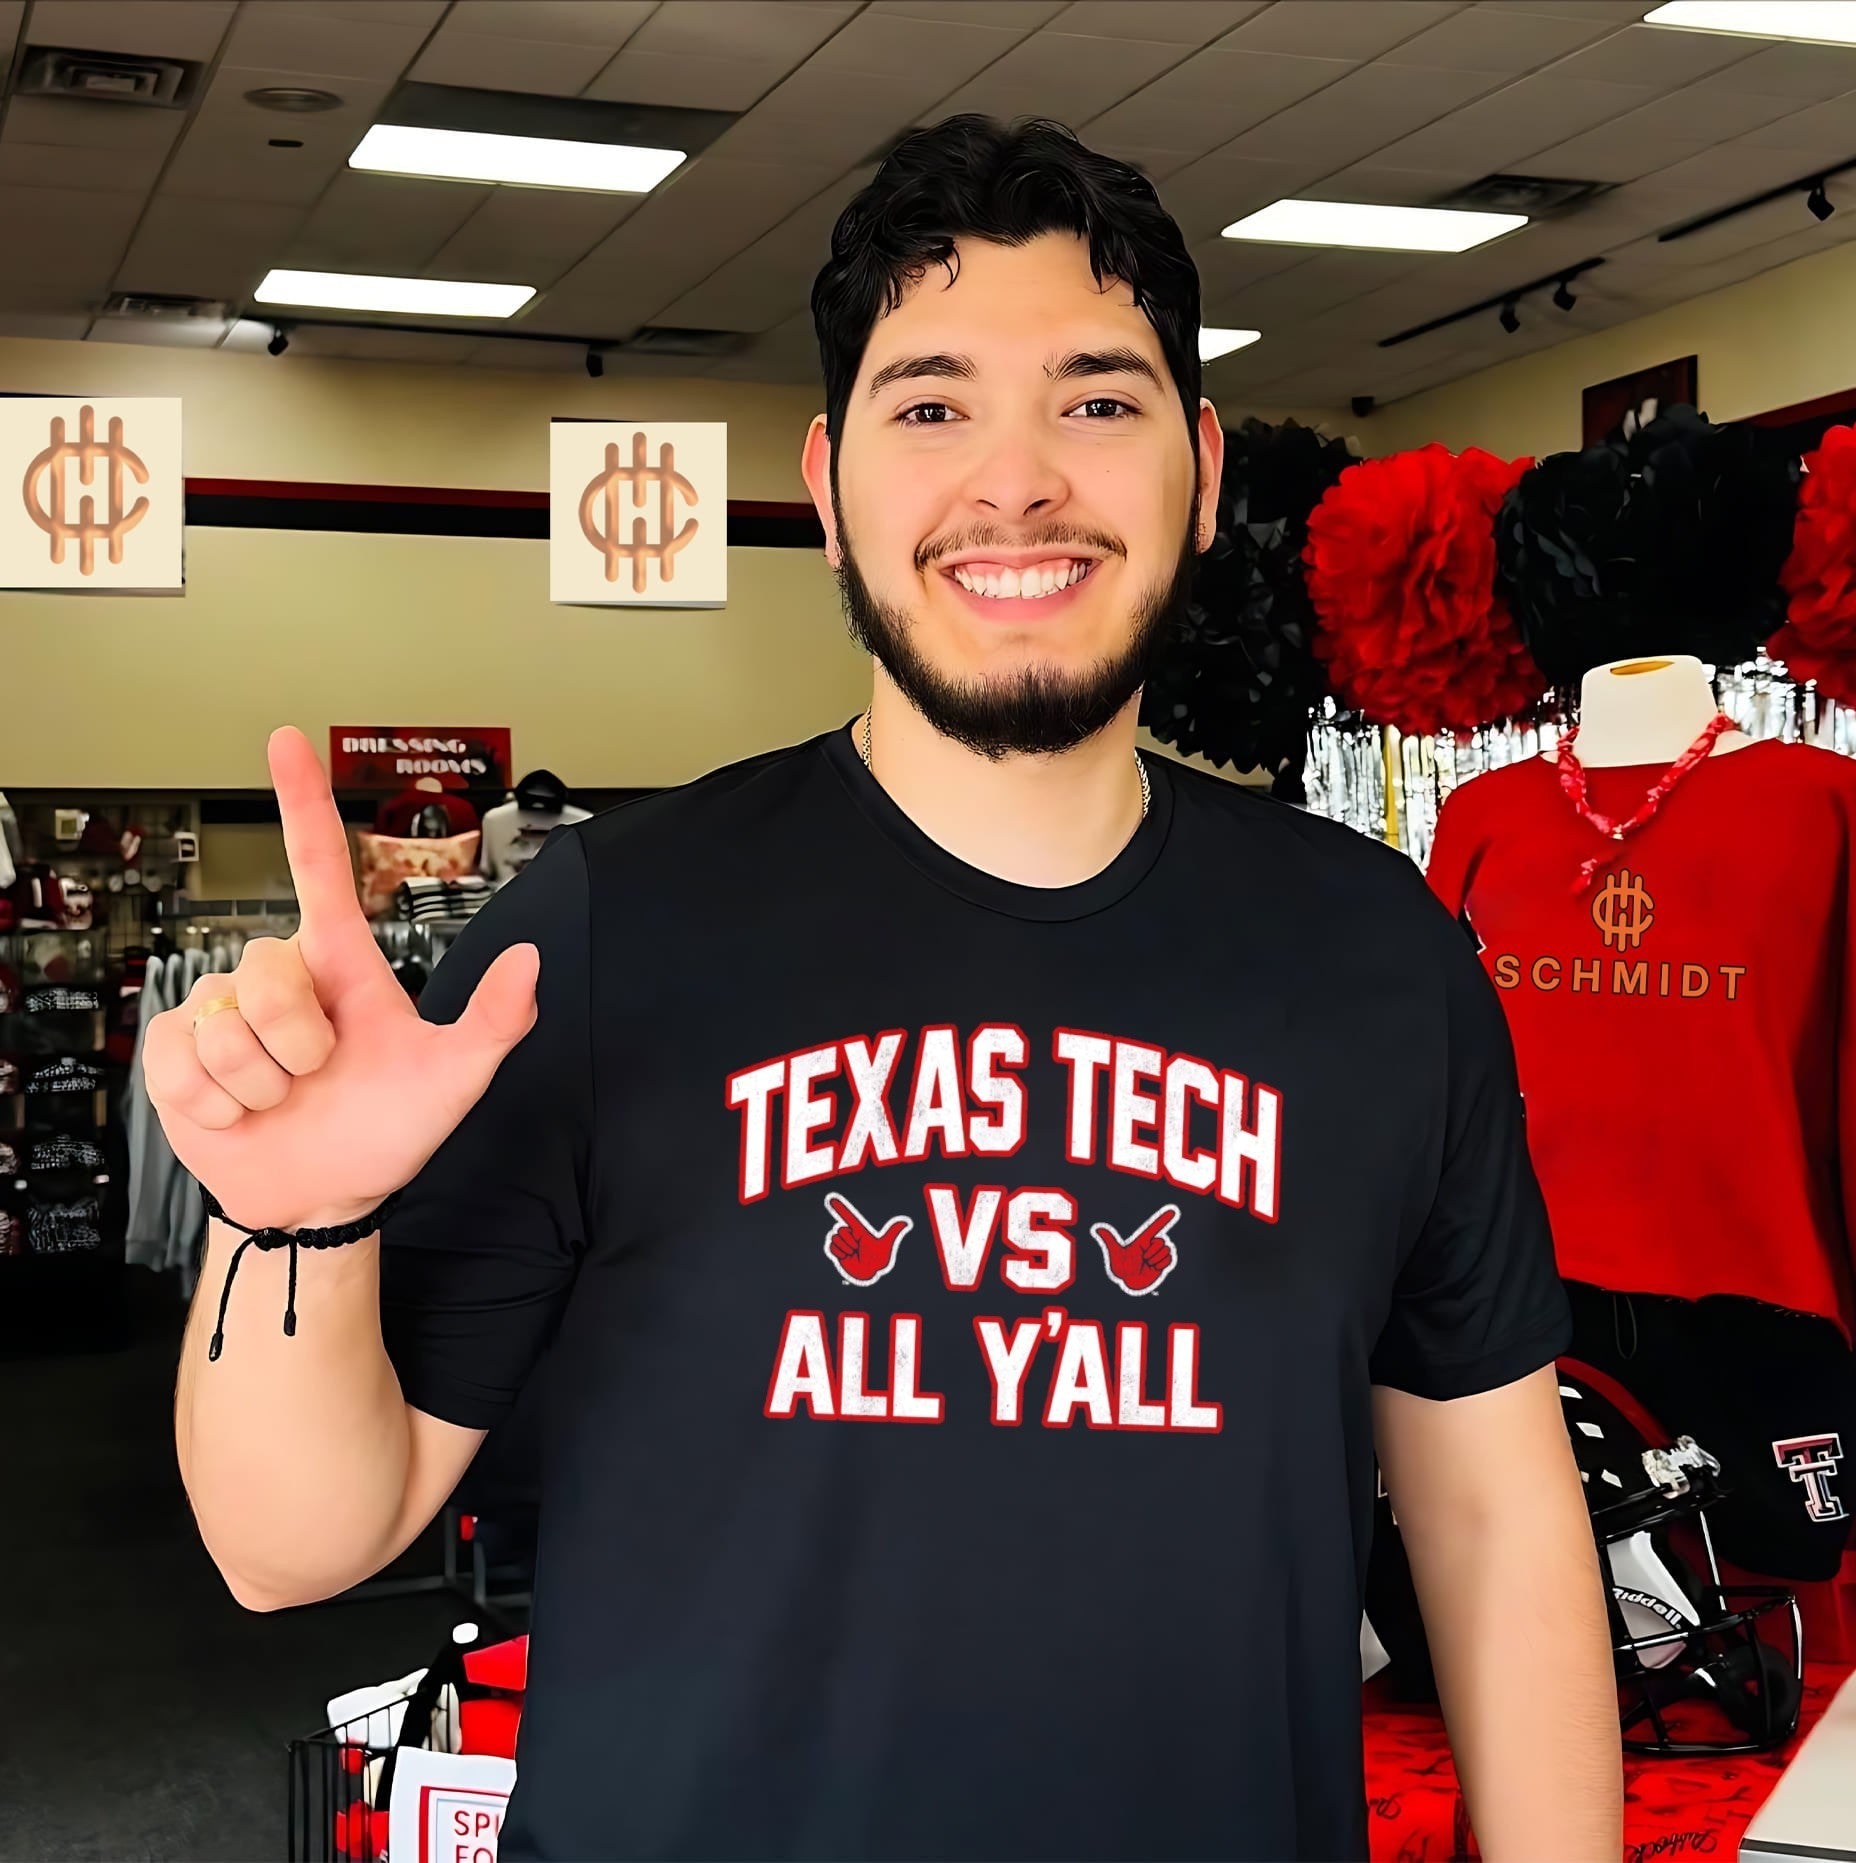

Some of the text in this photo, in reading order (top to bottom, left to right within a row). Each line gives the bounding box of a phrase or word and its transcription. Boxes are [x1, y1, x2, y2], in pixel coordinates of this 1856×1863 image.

[342, 737, 467, 754] DRESSING
[396, 758, 487, 775] ROOMS
[1494, 954, 1746, 1000] SCHMIDT
[726, 1022, 1282, 1223] TEXAS TECH
[924, 1183, 1077, 1293] VS
[764, 1306, 1223, 1434] ALL Y'ALL
